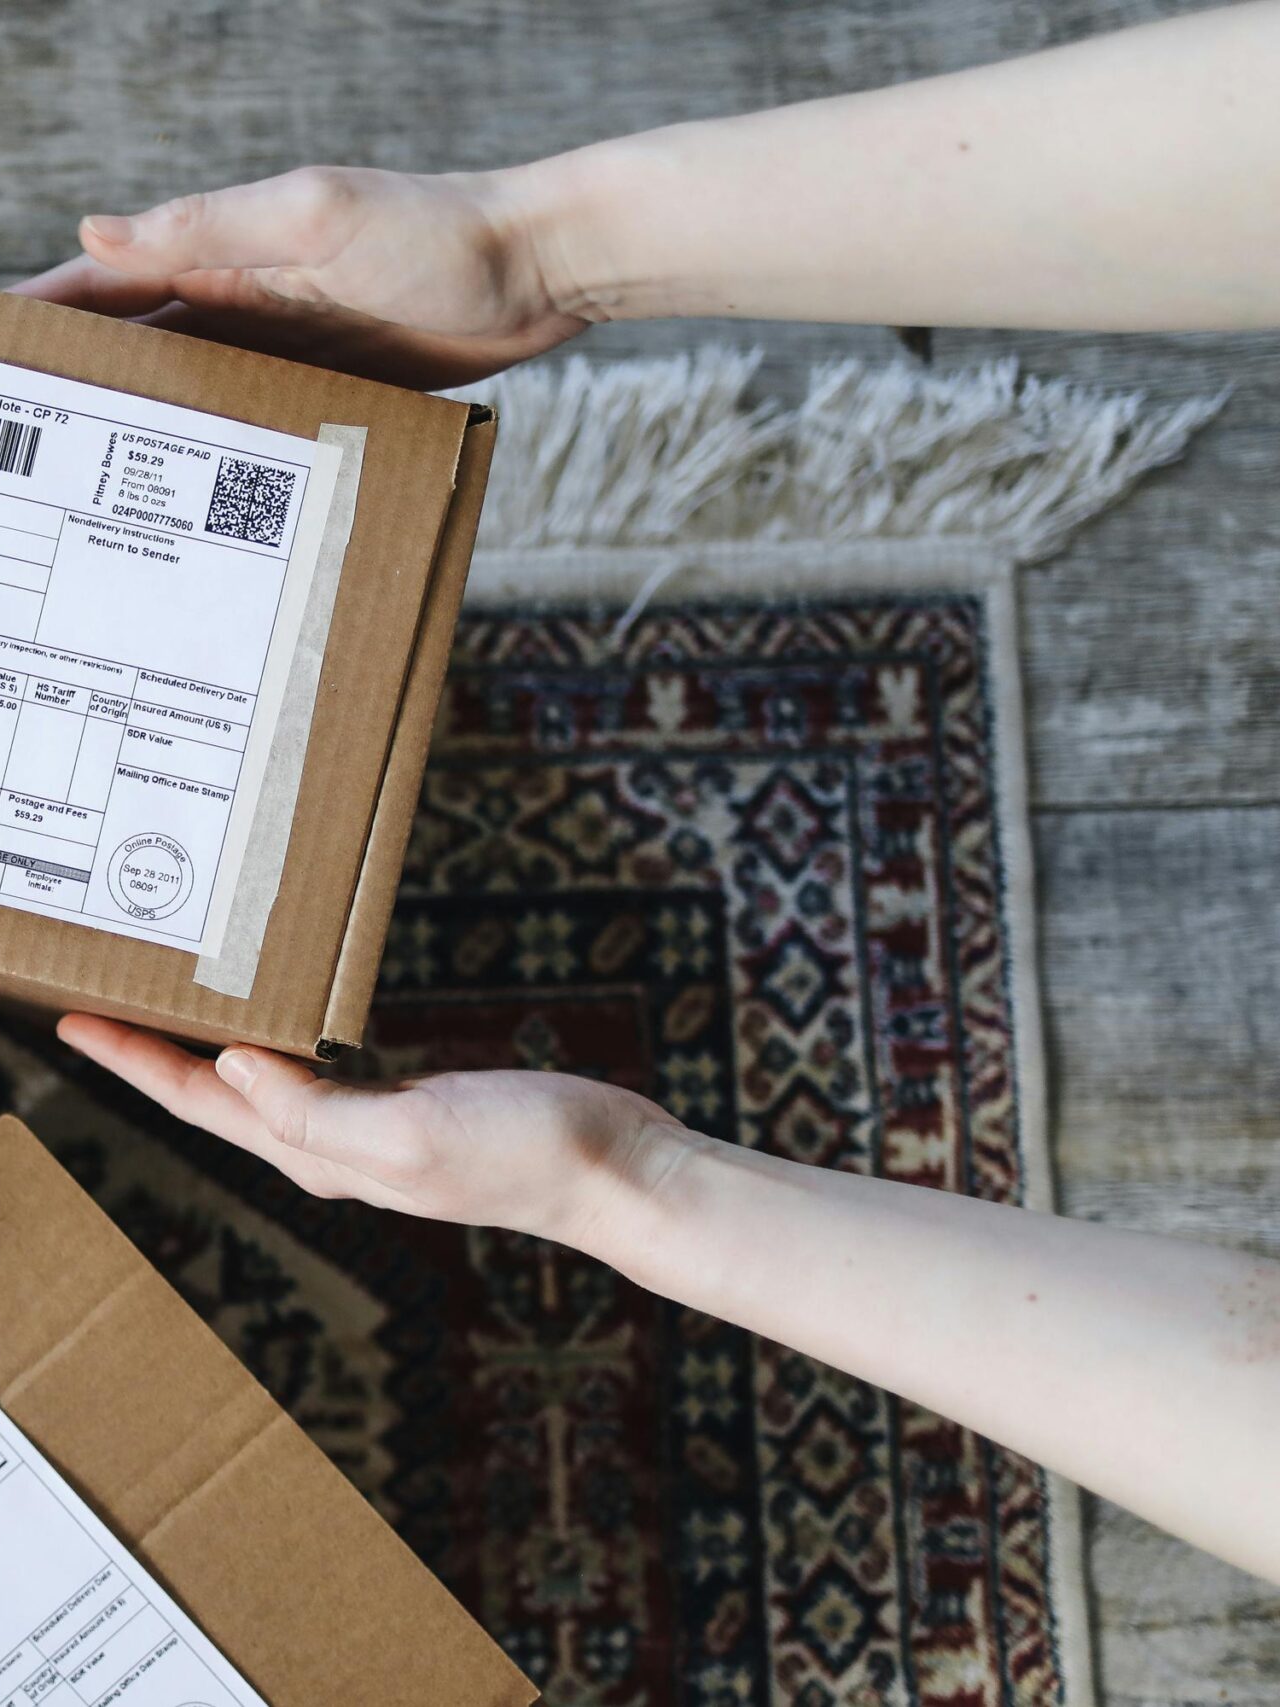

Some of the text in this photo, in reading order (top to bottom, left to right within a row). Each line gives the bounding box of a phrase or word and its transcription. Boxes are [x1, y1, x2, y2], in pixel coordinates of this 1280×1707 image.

[32, 407, 52, 420] CP
[54, 411, 69, 425] 72
[121, 432, 211, 461] US POSTAGE PAID
[92, 431, 118, 506] Pitney Bowes
[127, 450, 165, 467] $59.29
[123, 466, 163, 483] 09/28/11
[117, 488, 125, 498] 8
[126, 490, 140, 502] lbs
[150, 498, 167, 508] ozs
[120, 477, 176, 498] From 08091
[111, 503, 194, 532] 024P0007775060
[67, 514, 175, 546] Nondelivery Instructions
[87, 534, 181, 564] Return to Sender
[126, 728, 173, 747] SDR Value
[8, 793, 88, 820] Postage and Fees
[123, 863, 180, 885] Sep 28 2011
[129, 879, 158, 894] 08091
